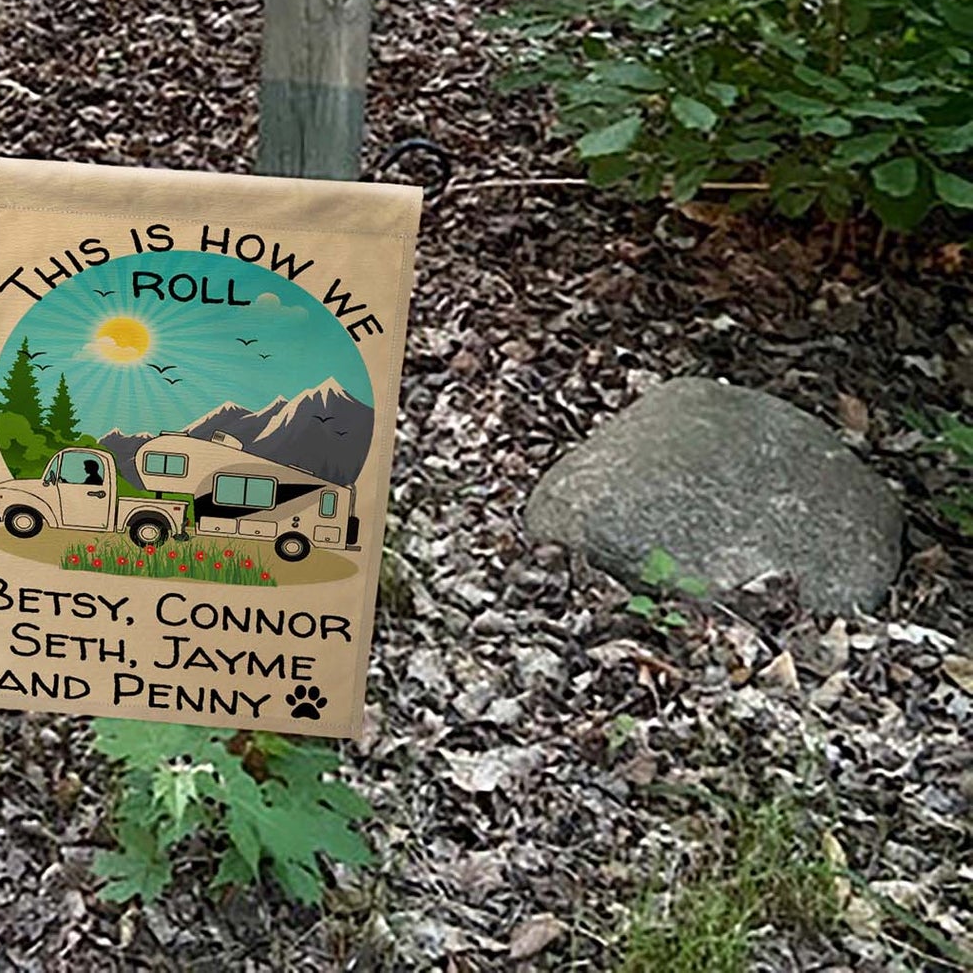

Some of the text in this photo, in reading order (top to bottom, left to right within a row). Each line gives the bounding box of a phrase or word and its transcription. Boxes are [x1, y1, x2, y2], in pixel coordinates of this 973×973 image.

[129, 223, 175, 254] IS
[200, 224, 315, 281] HOW
[322, 277, 385, 343] WE
[132, 270, 252, 307] ROLL
[155, 592, 352, 643] CONNOR
[9, 622, 316, 681] SETH, JAYME
[113, 672, 272, 719] PENNY
